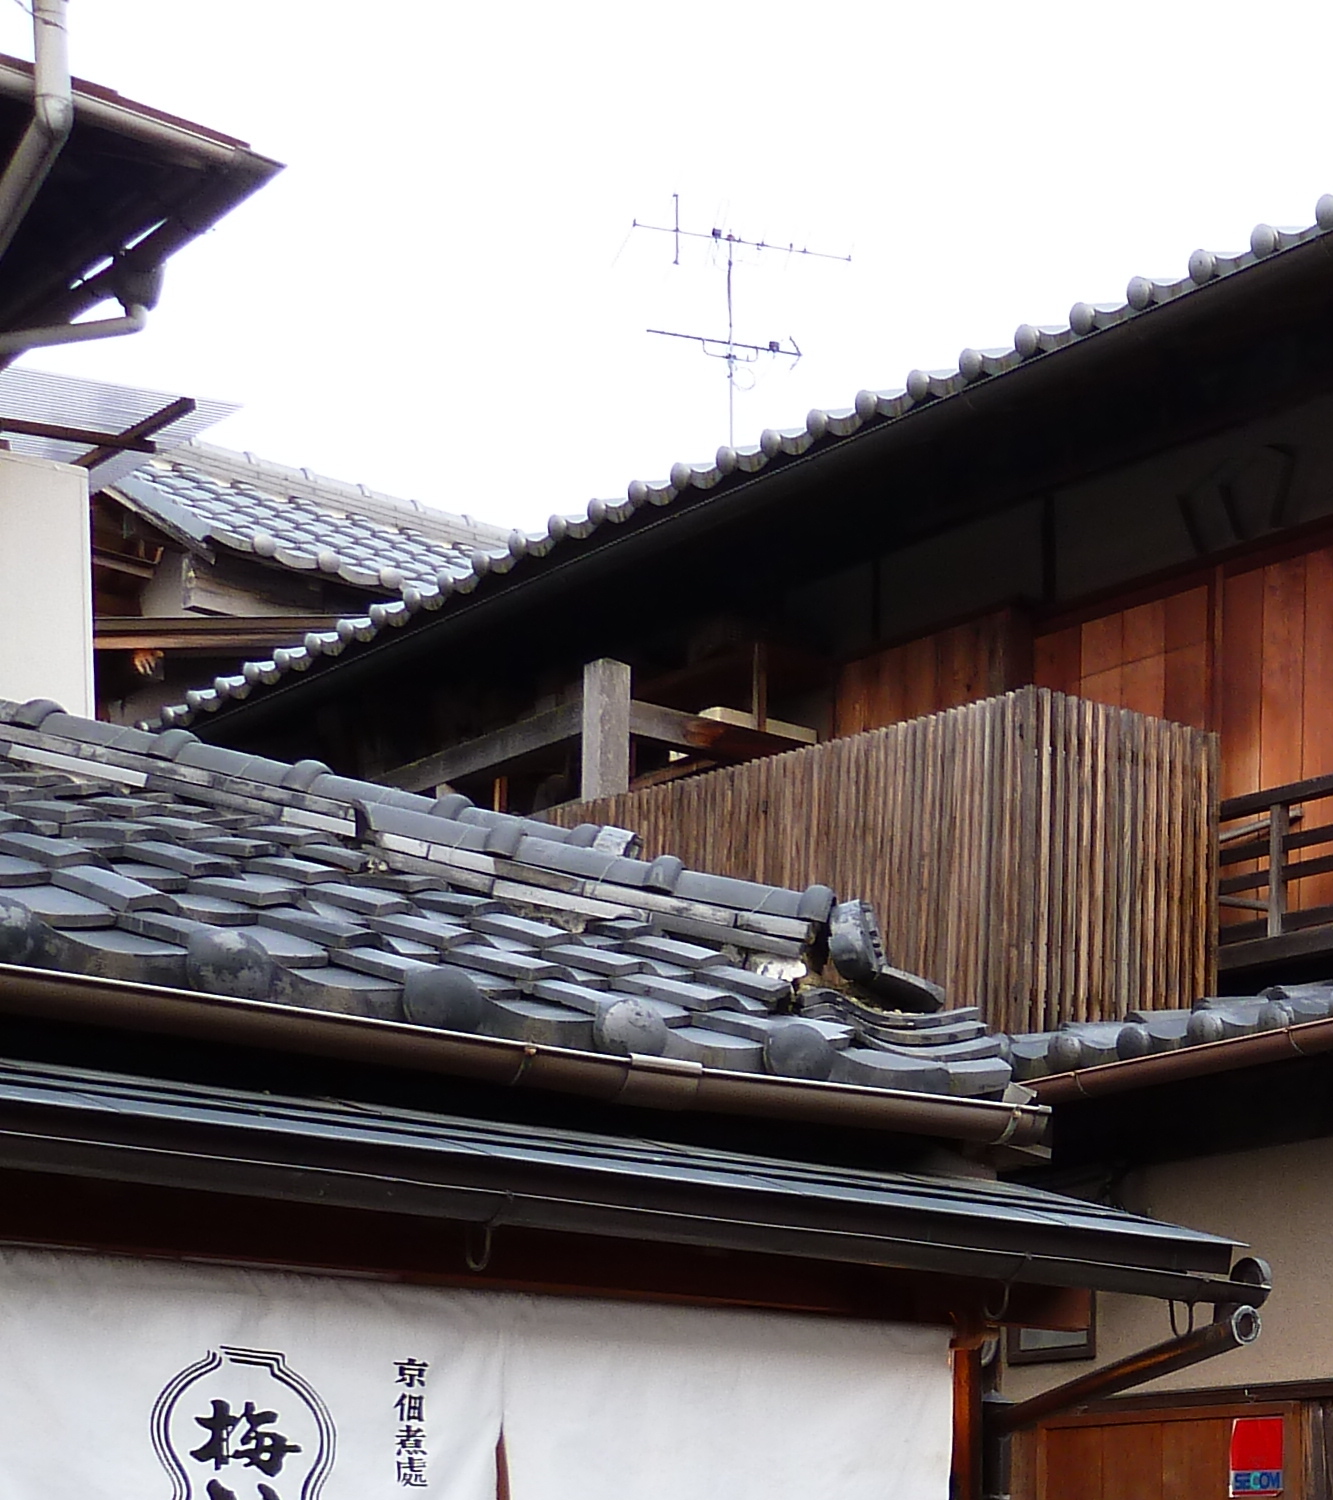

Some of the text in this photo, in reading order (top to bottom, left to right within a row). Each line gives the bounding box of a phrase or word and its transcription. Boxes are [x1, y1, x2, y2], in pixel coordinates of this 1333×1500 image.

[392, 1356, 430, 1488] 京佃煮處
[1234, 1471, 1281, 1490] SECOM
